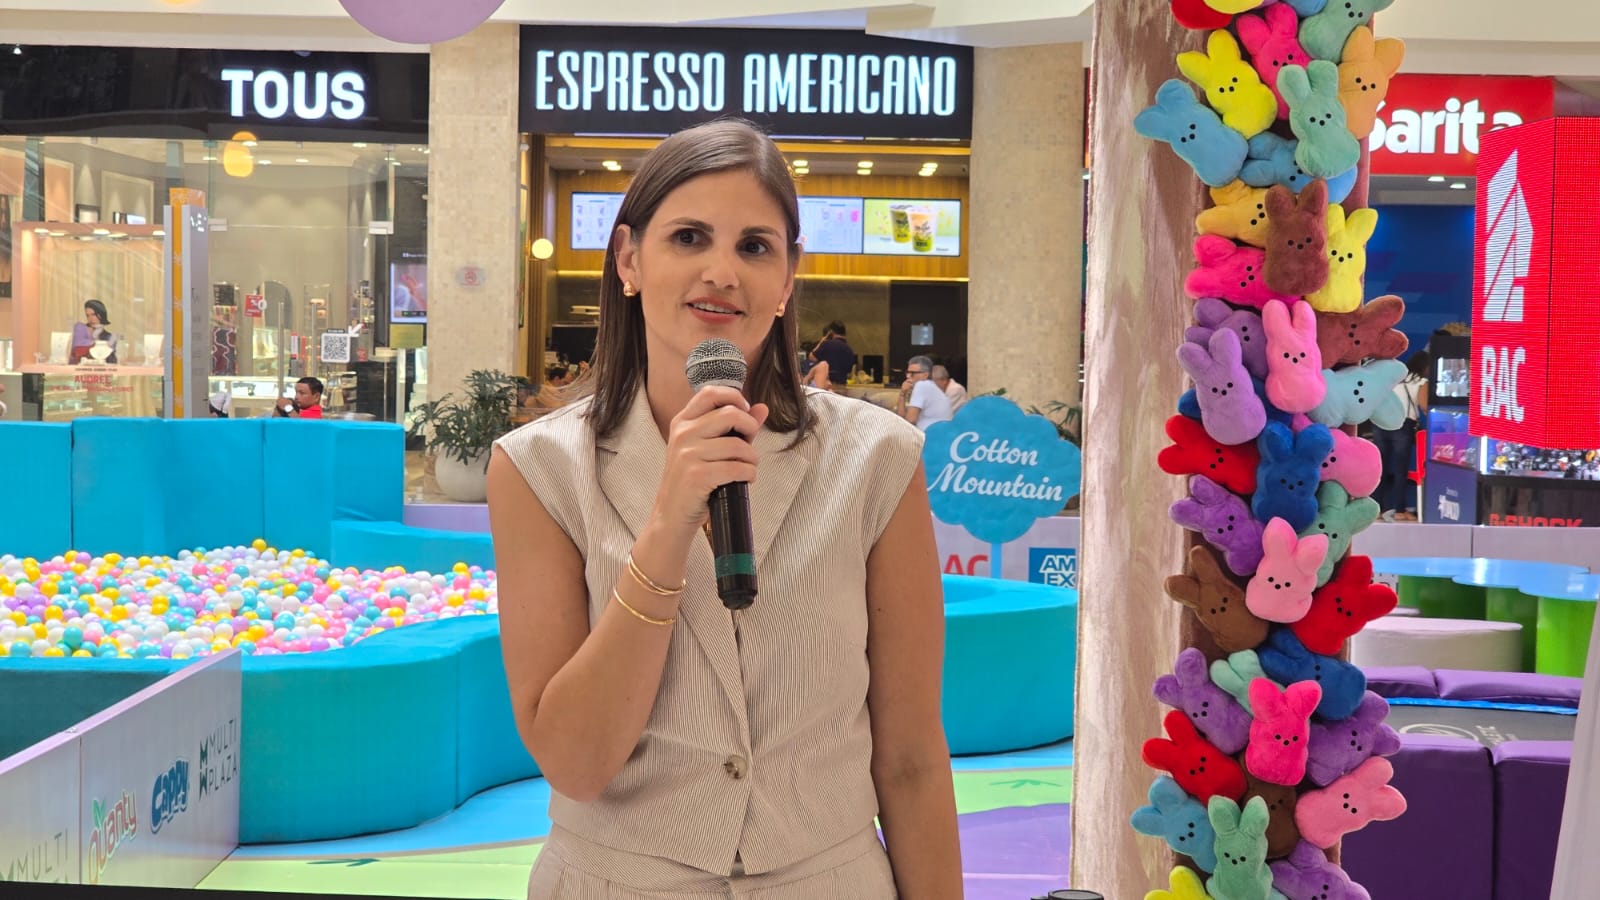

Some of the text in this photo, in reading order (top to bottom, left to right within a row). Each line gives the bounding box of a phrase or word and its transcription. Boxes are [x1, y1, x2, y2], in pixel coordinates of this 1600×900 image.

[221, 69, 366, 120] TOUS
[535, 49, 957, 116] ESPRESSO AMERICANO
[1480, 345, 1526, 423] BAC
[949, 431, 1038, 466] Cotton
[927, 463, 1063, 502] Mountain
[944, 554, 988, 576] AC
[1039, 554, 1076, 573] AM
[209, 717, 237, 760] MULTI
[208, 752, 238, 795] PLAZA
[151, 758, 190, 834] Cappy
[16, 827, 69, 880] MULTI
